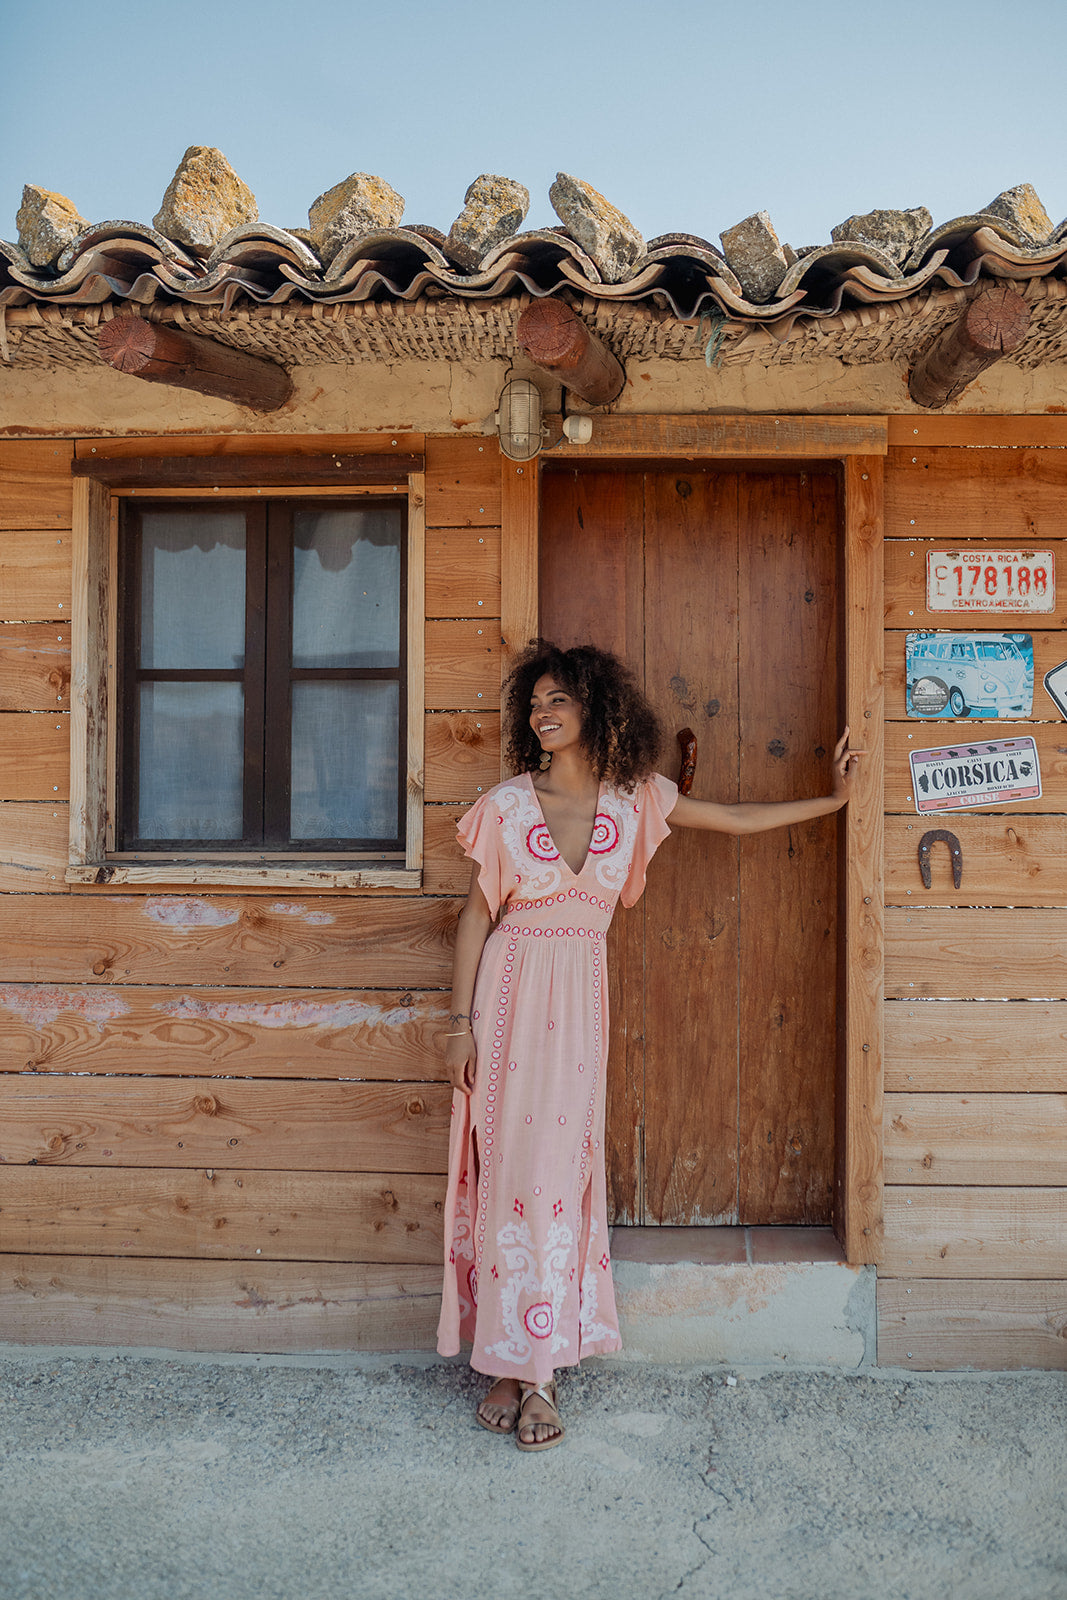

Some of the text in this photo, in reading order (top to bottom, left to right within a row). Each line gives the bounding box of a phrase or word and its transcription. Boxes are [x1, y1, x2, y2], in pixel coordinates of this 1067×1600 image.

[953, 566, 1047, 596] 178188
[952, 599, 1030, 607] CENTROAMERICA
[932, 759, 1019, 790] CORSICA
[960, 793, 1000, 805] CORSE
